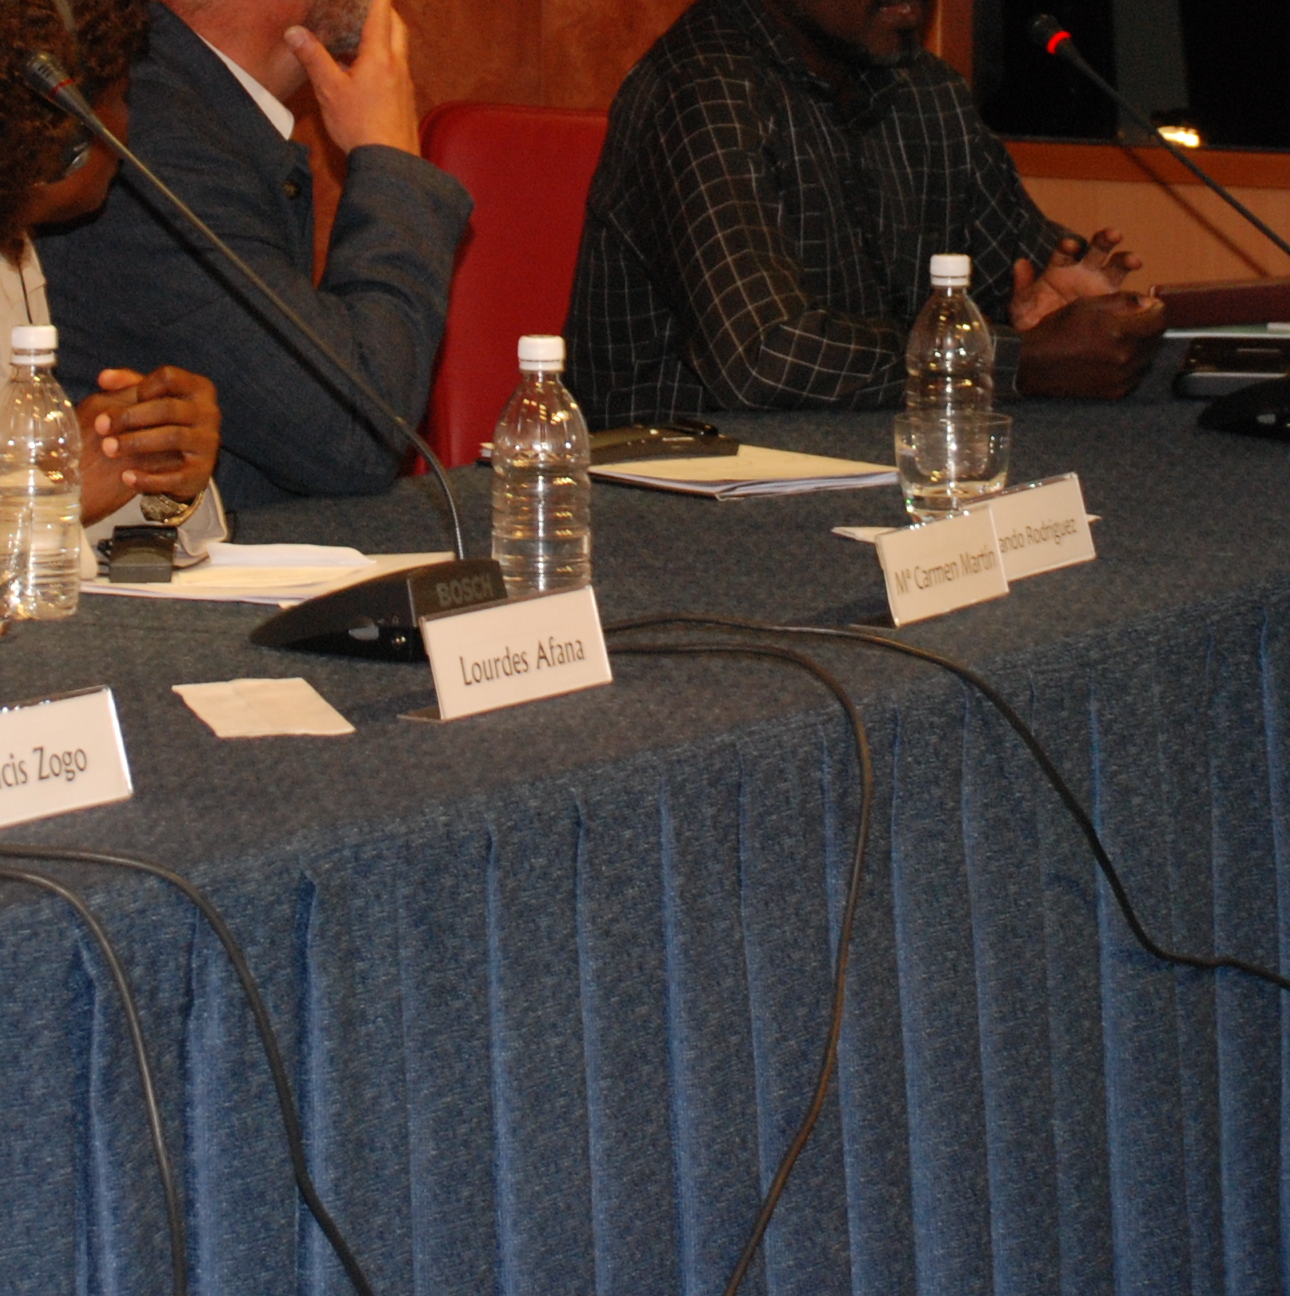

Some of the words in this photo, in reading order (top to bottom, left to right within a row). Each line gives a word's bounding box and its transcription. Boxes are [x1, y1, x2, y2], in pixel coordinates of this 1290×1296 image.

[1026, 517, 1077, 545] Rodríguez
[914, 559, 959, 590] Carmen
[959, 545, 999, 577] Martín
[436, 573, 494, 607] BOSCH
[459, 646, 529, 686] Lourdes
[536, 636, 586, 671] Afana
[32, 745, 88, 782] Zogo
